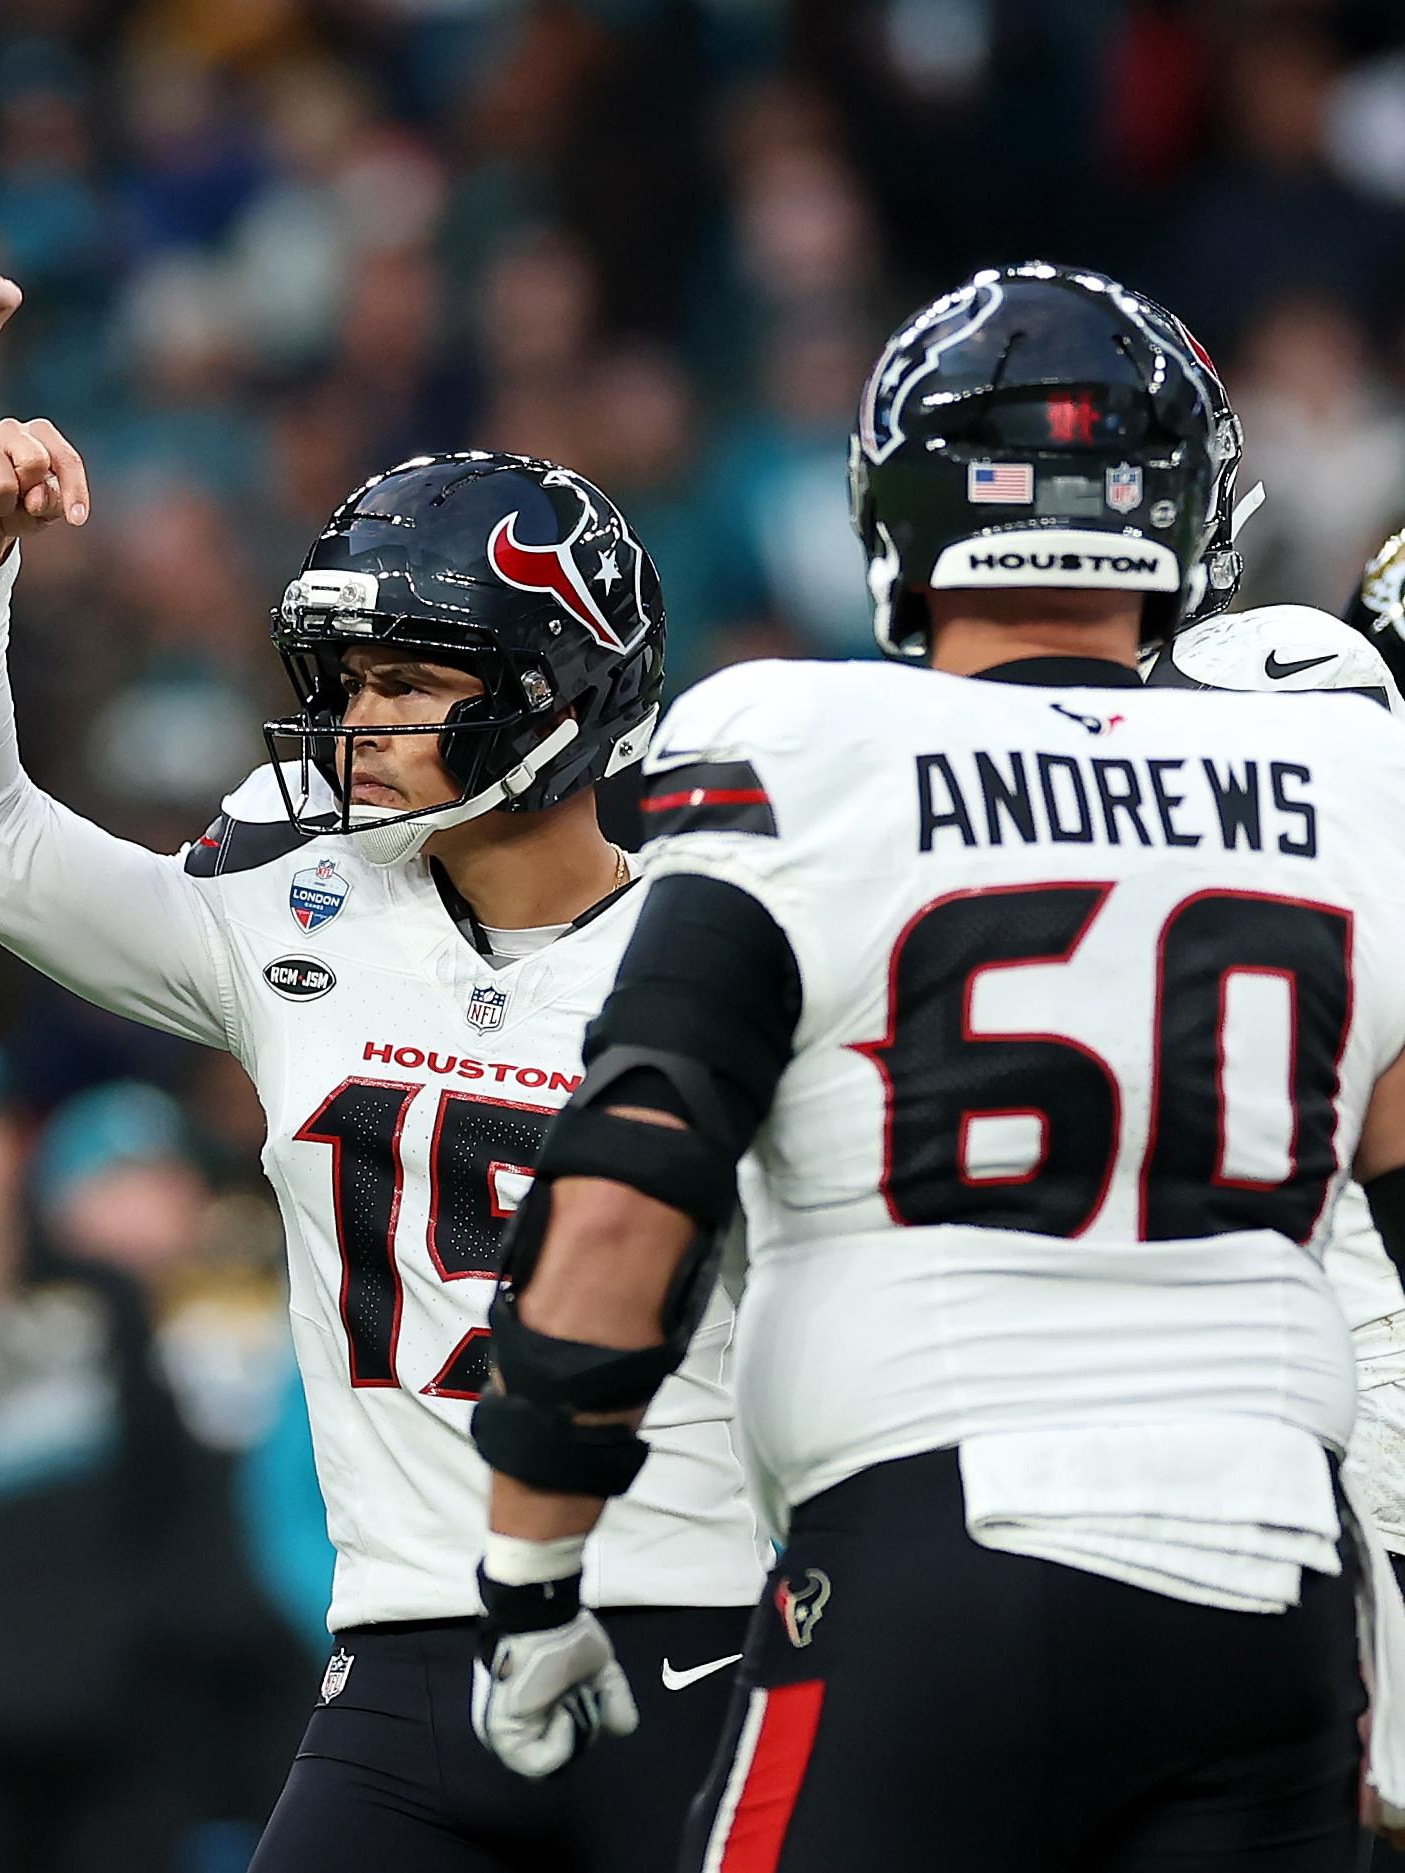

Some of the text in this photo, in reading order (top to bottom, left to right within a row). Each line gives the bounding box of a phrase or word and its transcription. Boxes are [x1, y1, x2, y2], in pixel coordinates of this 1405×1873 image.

[969, 554, 1159, 573] HOUSTON
[915, 751, 1317, 859] ANDREWS
[293, 888, 341, 908] LONDON
[470, 1003, 498, 1025] NFL
[362, 1041, 582, 1094] HOUSTON
[840, 880, 1355, 1244] 60
